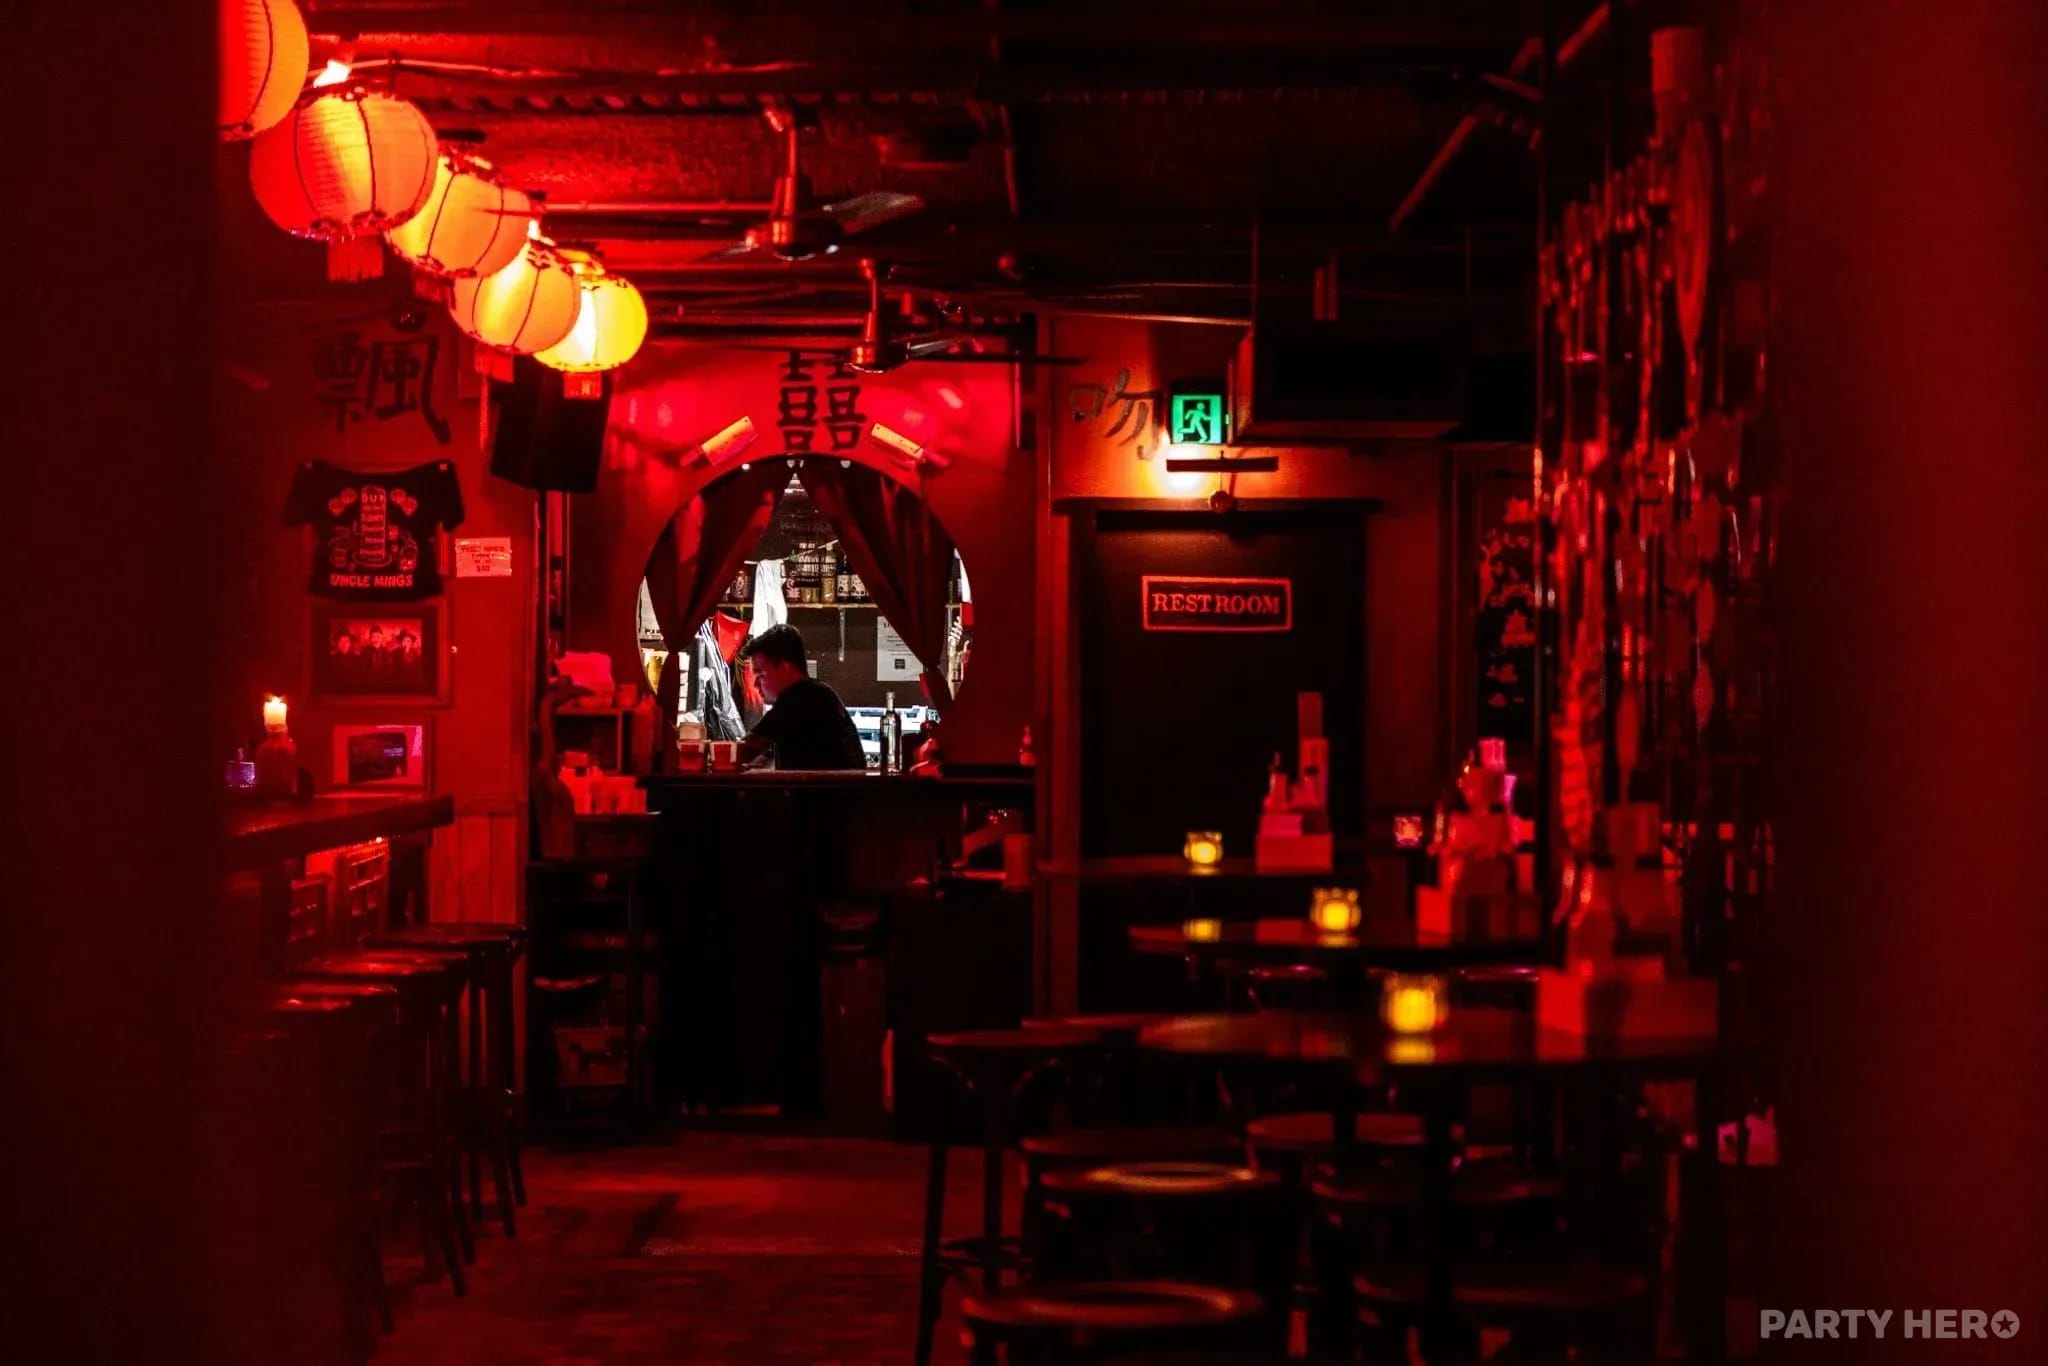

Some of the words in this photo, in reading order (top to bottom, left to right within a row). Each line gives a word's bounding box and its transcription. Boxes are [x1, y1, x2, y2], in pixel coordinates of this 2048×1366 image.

[329, 573, 370, 588] UNCLE
[373, 573, 414, 588] MINGS
[1151, 593, 1281, 615] RESTROOM
